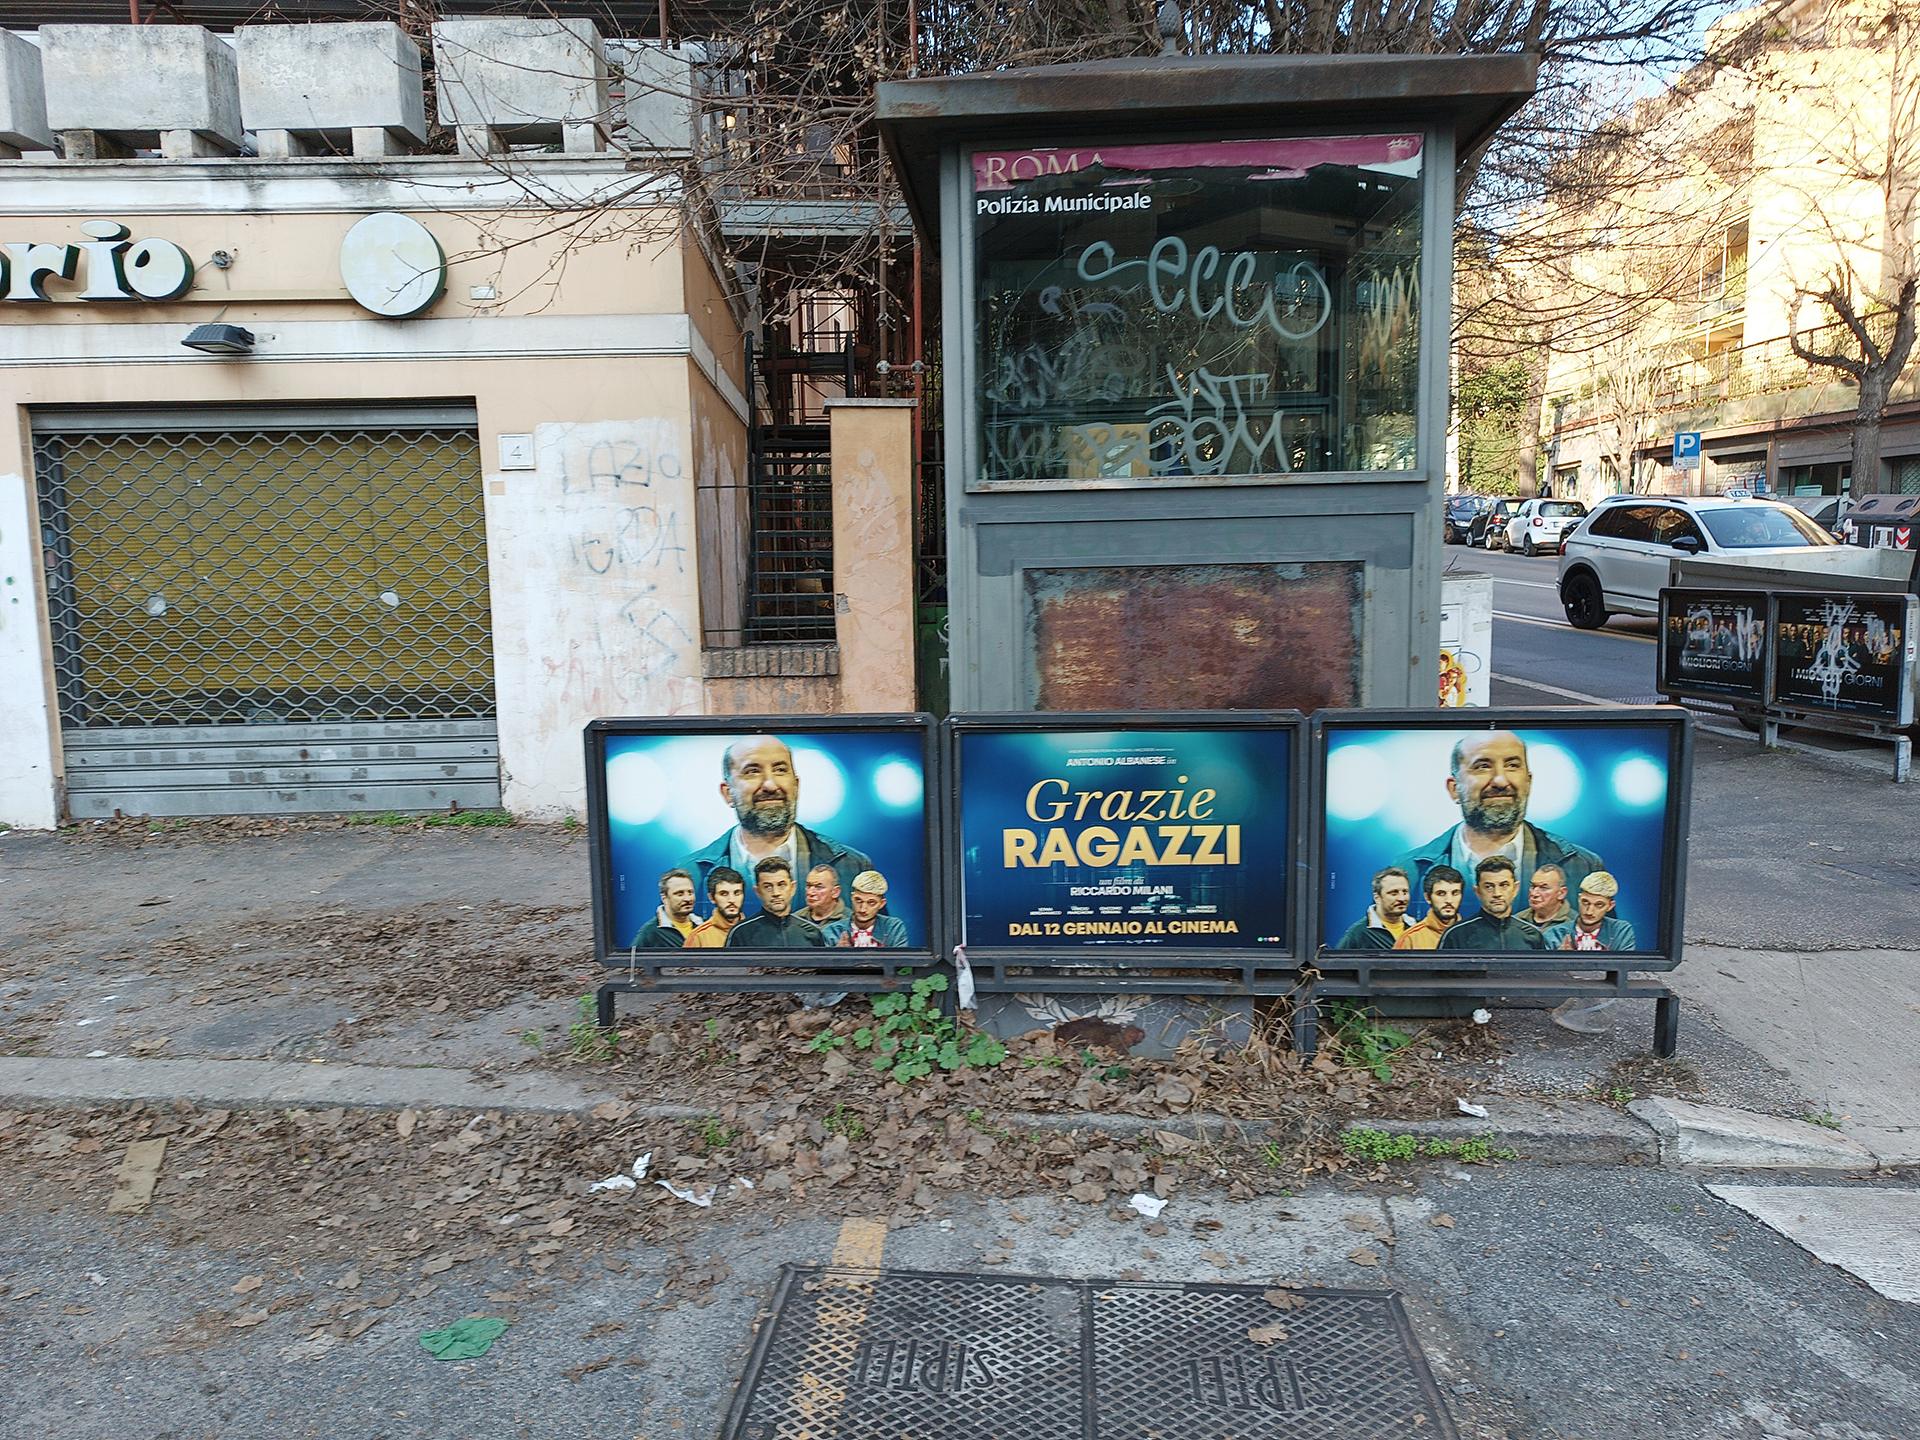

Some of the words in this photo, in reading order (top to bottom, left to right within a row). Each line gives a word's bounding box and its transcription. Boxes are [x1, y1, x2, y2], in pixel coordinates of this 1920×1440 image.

[977, 195, 1039, 214] Polizia
[1044, 192, 1152, 213] Municipale
[0, 220, 195, 301] rio
[510, 446, 522, 459] 4
[1679, 435, 1696, 457] P
[1843, 672, 1885, 688] GIORNI
[1065, 757, 1114, 767] ANTONIO
[1114, 755, 1167, 766] ALBANESE
[1025, 775, 1217, 823] Grazie
[1003, 825, 1241, 868] RAGAZZI
[1070, 886, 1131, 896] RICCARDO
[1132, 885, 1174, 895] MILANI
[1008, 923, 1042, 936] DAL
[1044, 923, 1061, 935] 12
[1062, 921, 1142, 935] GENNAIO
[1144, 921, 1167, 934] AL
[1168, 919, 1239, 934] CINEMA
